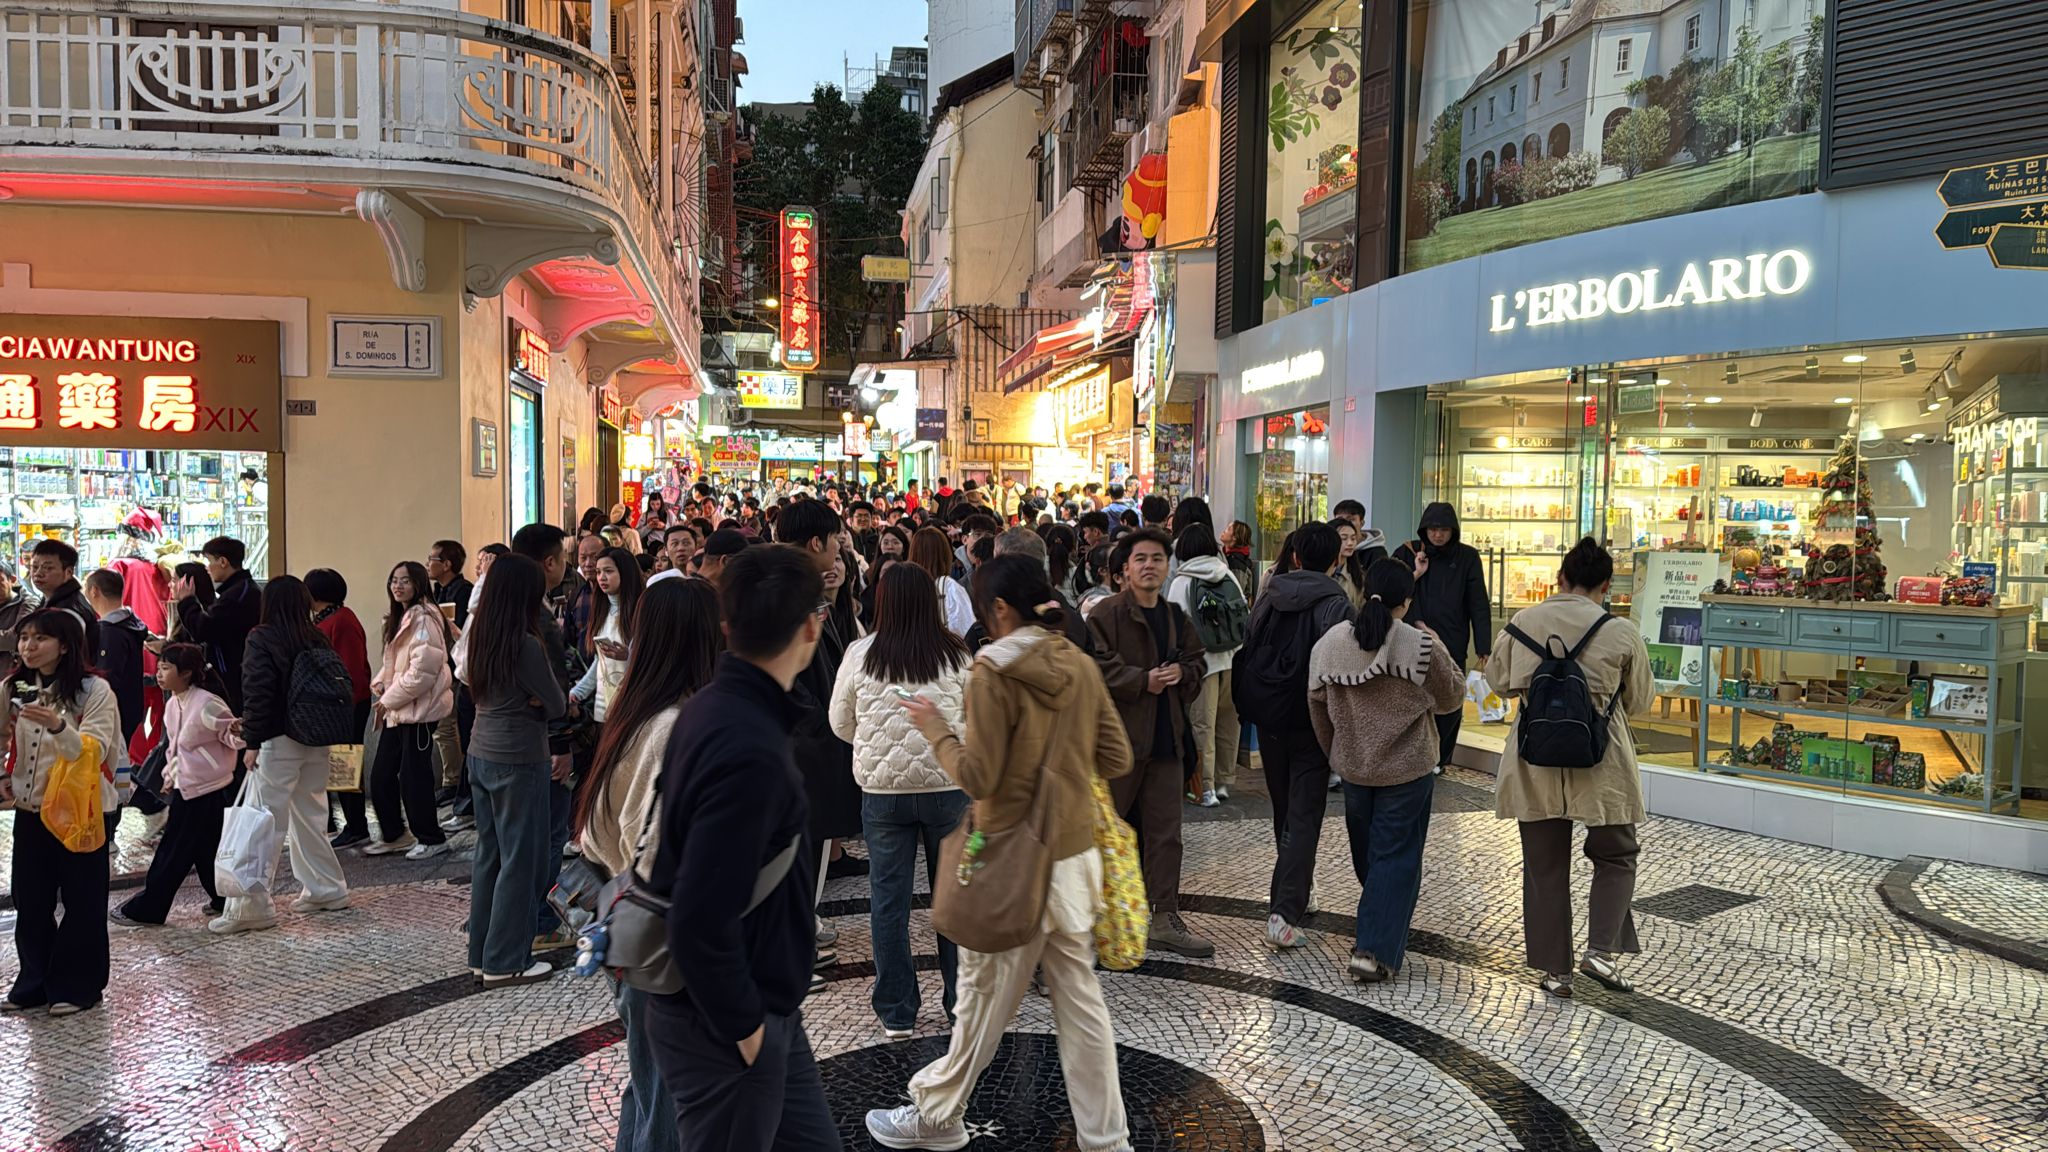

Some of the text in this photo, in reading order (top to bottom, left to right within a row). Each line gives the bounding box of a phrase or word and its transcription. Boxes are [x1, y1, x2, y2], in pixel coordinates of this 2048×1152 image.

[1985, 160, 2048, 181] 大三巴
[1988, 177, 2024, 191] RUÍNAS
[2026, 177, 2038, 186] DE
[2004, 188, 2027, 197] Ruins
[2031, 246, 2048, 255] LAR
[1489, 249, 1810, 333] L'ERBOLARIO
[362, 330, 379, 339] RUA
[0, 336, 196, 362] CIAWANTUNG
[365, 341, 377, 349] DE
[236, 353, 257, 364] XIX
[345, 351, 397, 361] S. DOMINGOS
[203, 407, 259, 433] XIX
[1521, 437, 1553, 447] CARE
[1750, 438, 1815, 449] BODY CARE
